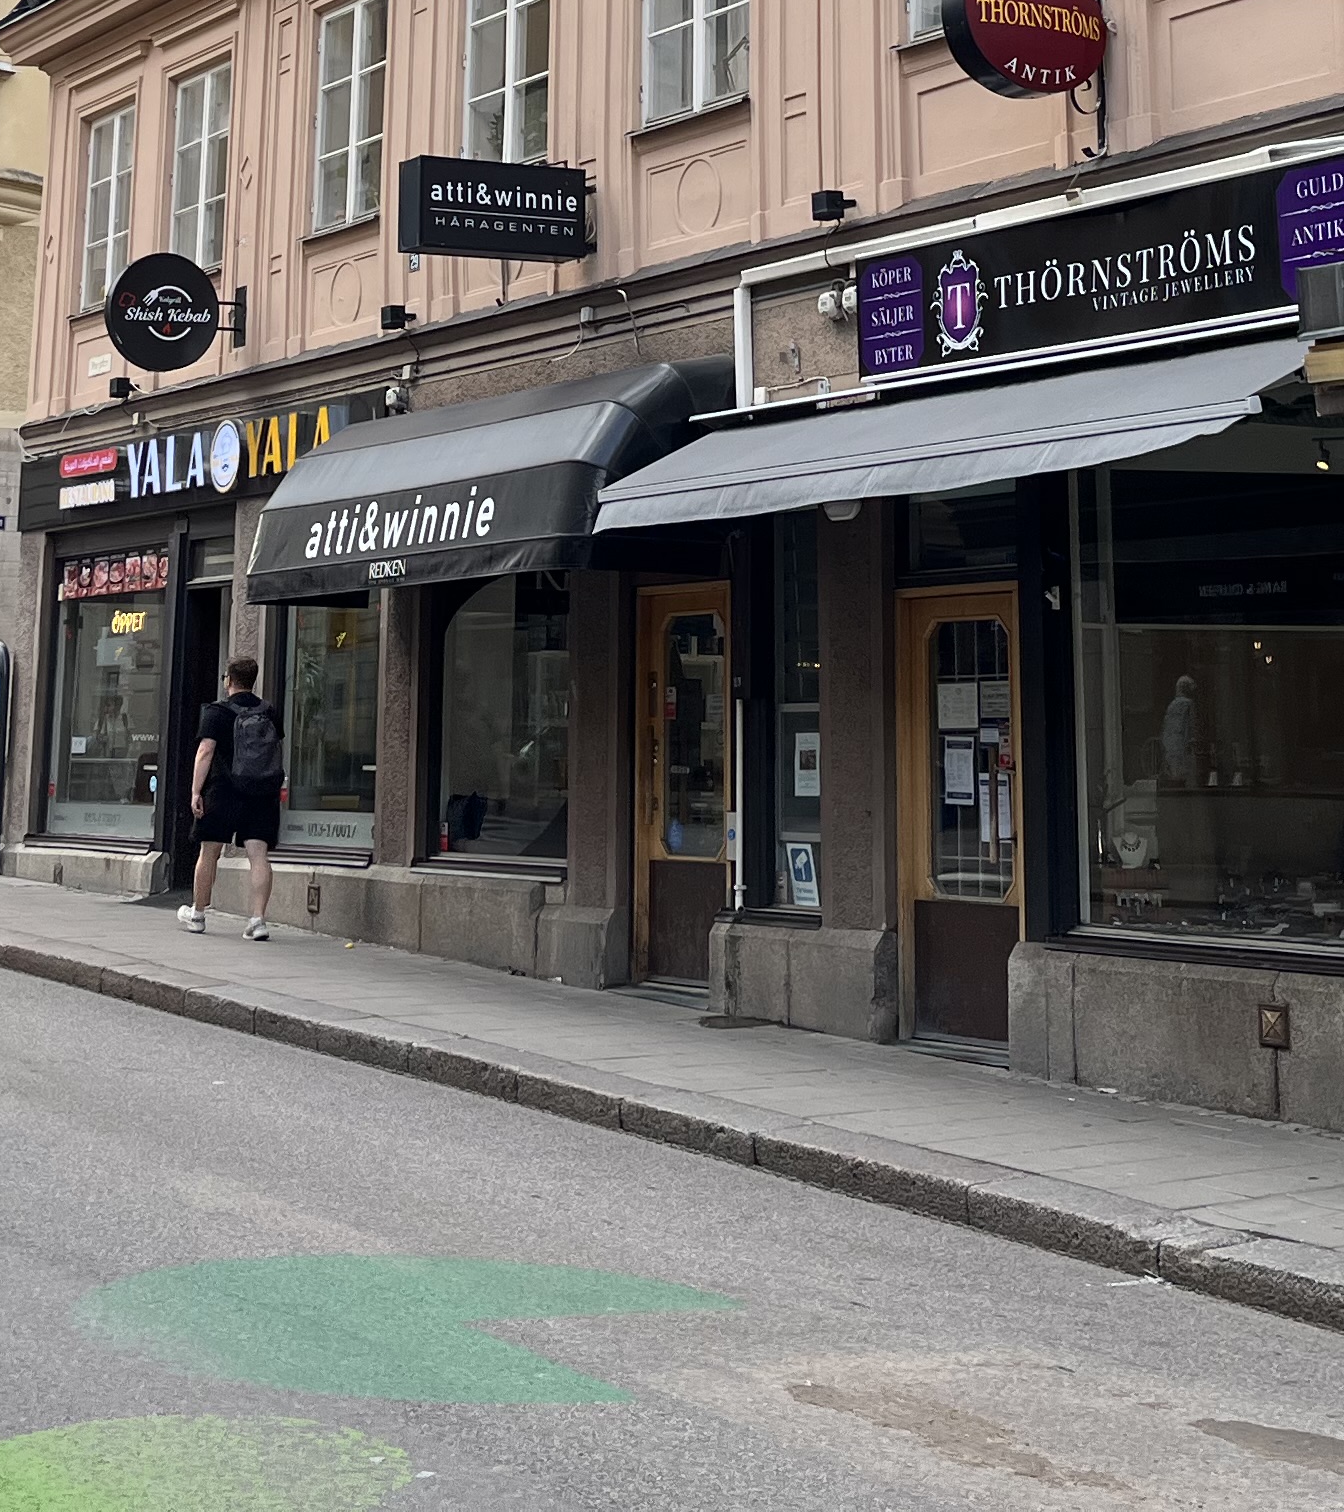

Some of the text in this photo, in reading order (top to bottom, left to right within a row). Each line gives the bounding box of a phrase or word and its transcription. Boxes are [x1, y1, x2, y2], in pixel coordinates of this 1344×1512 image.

[1004, 57, 1077, 85] ANTIK
[430, 181, 578, 212] atti&winnie
[1296, 172, 1344, 199] GULD
[434, 216, 575, 237] HÅRAGENTEN
[409, 254, 419, 271] 29
[994, 224, 1256, 309] THÖRNSTRÖMS
[871, 266, 912, 289] KÖPER
[1092, 266, 1256, 312] VINTAGE JEWELLERY
[124, 306, 211, 323] Shish Kebab
[871, 305, 914, 327] SÄLJER
[947, 283, 970, 330] T
[874, 344, 914, 365] BYTER
[127, 432, 204, 498] YALA
[305, 486, 495, 559] atti&winnie
[368, 559, 407, 579] REDKEN
[111, 609, 147, 634] ÖPPET
